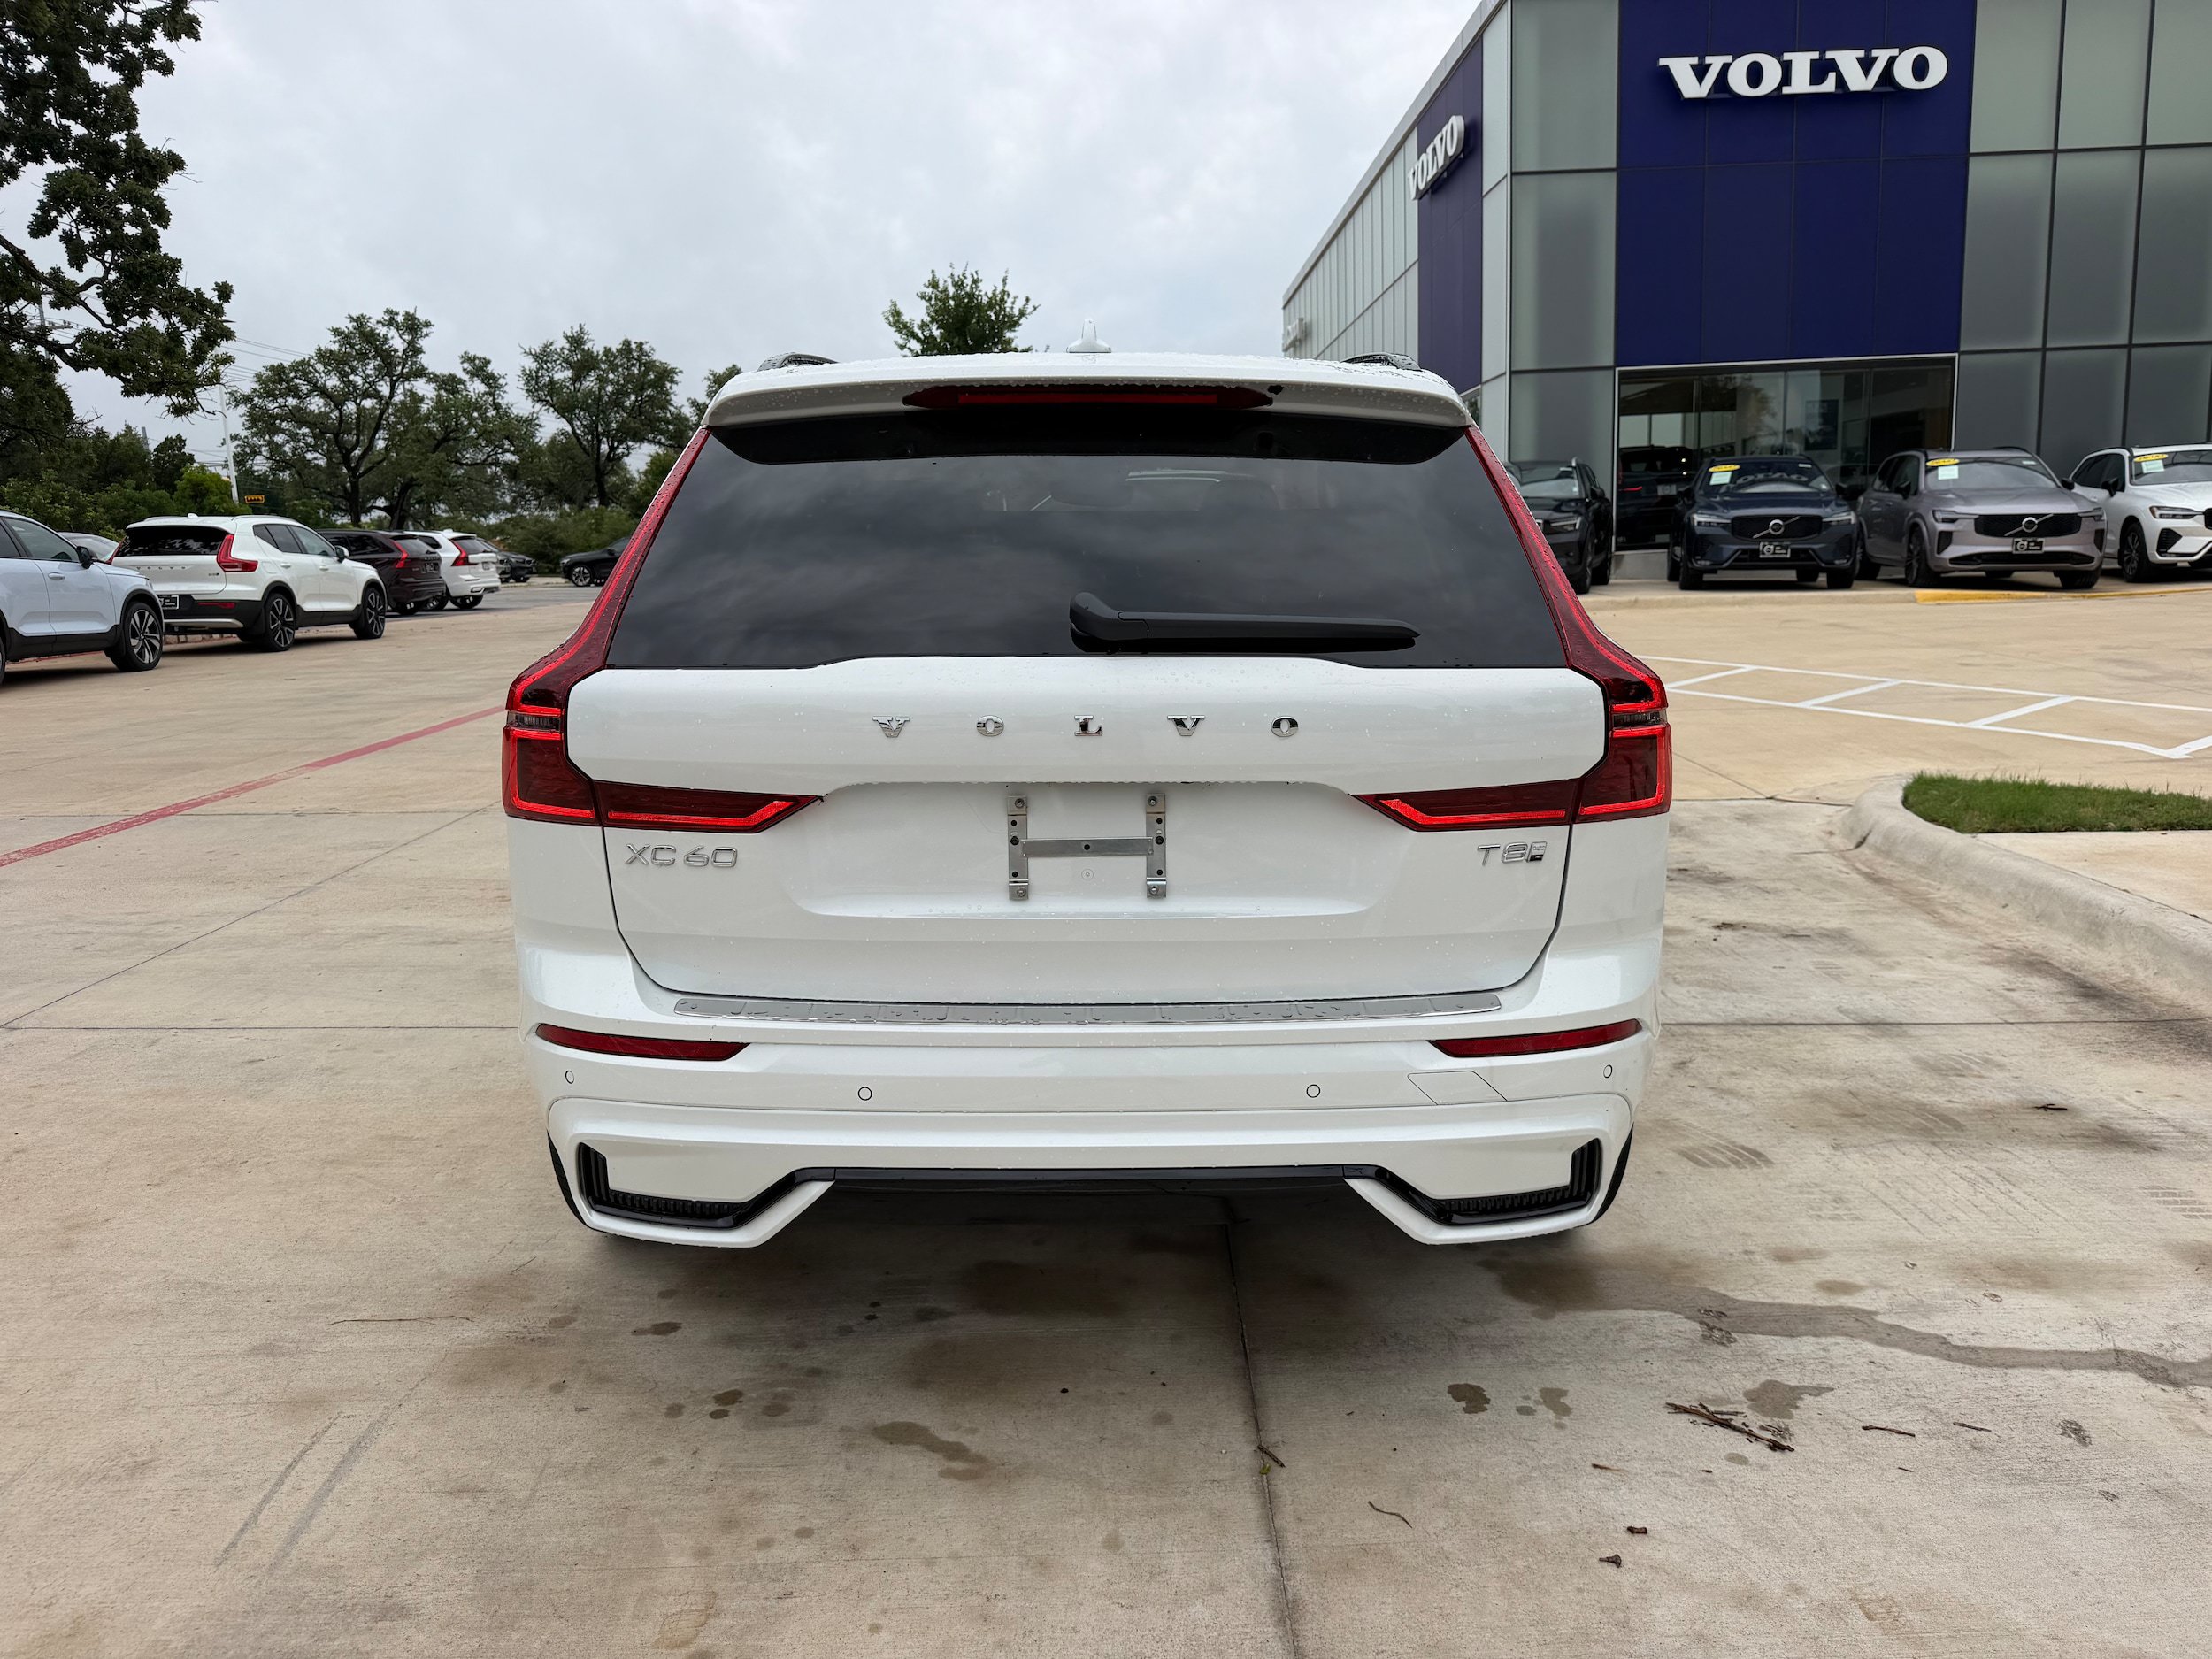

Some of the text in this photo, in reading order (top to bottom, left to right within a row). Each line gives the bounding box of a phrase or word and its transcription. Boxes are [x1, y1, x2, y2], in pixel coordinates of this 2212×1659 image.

[1658, 45, 1948, 98] VOLVO
[1408, 115, 1463, 201] VOLVO
[870, 714, 1299, 738] VOLVO
[1477, 841, 1529, 866] T8
